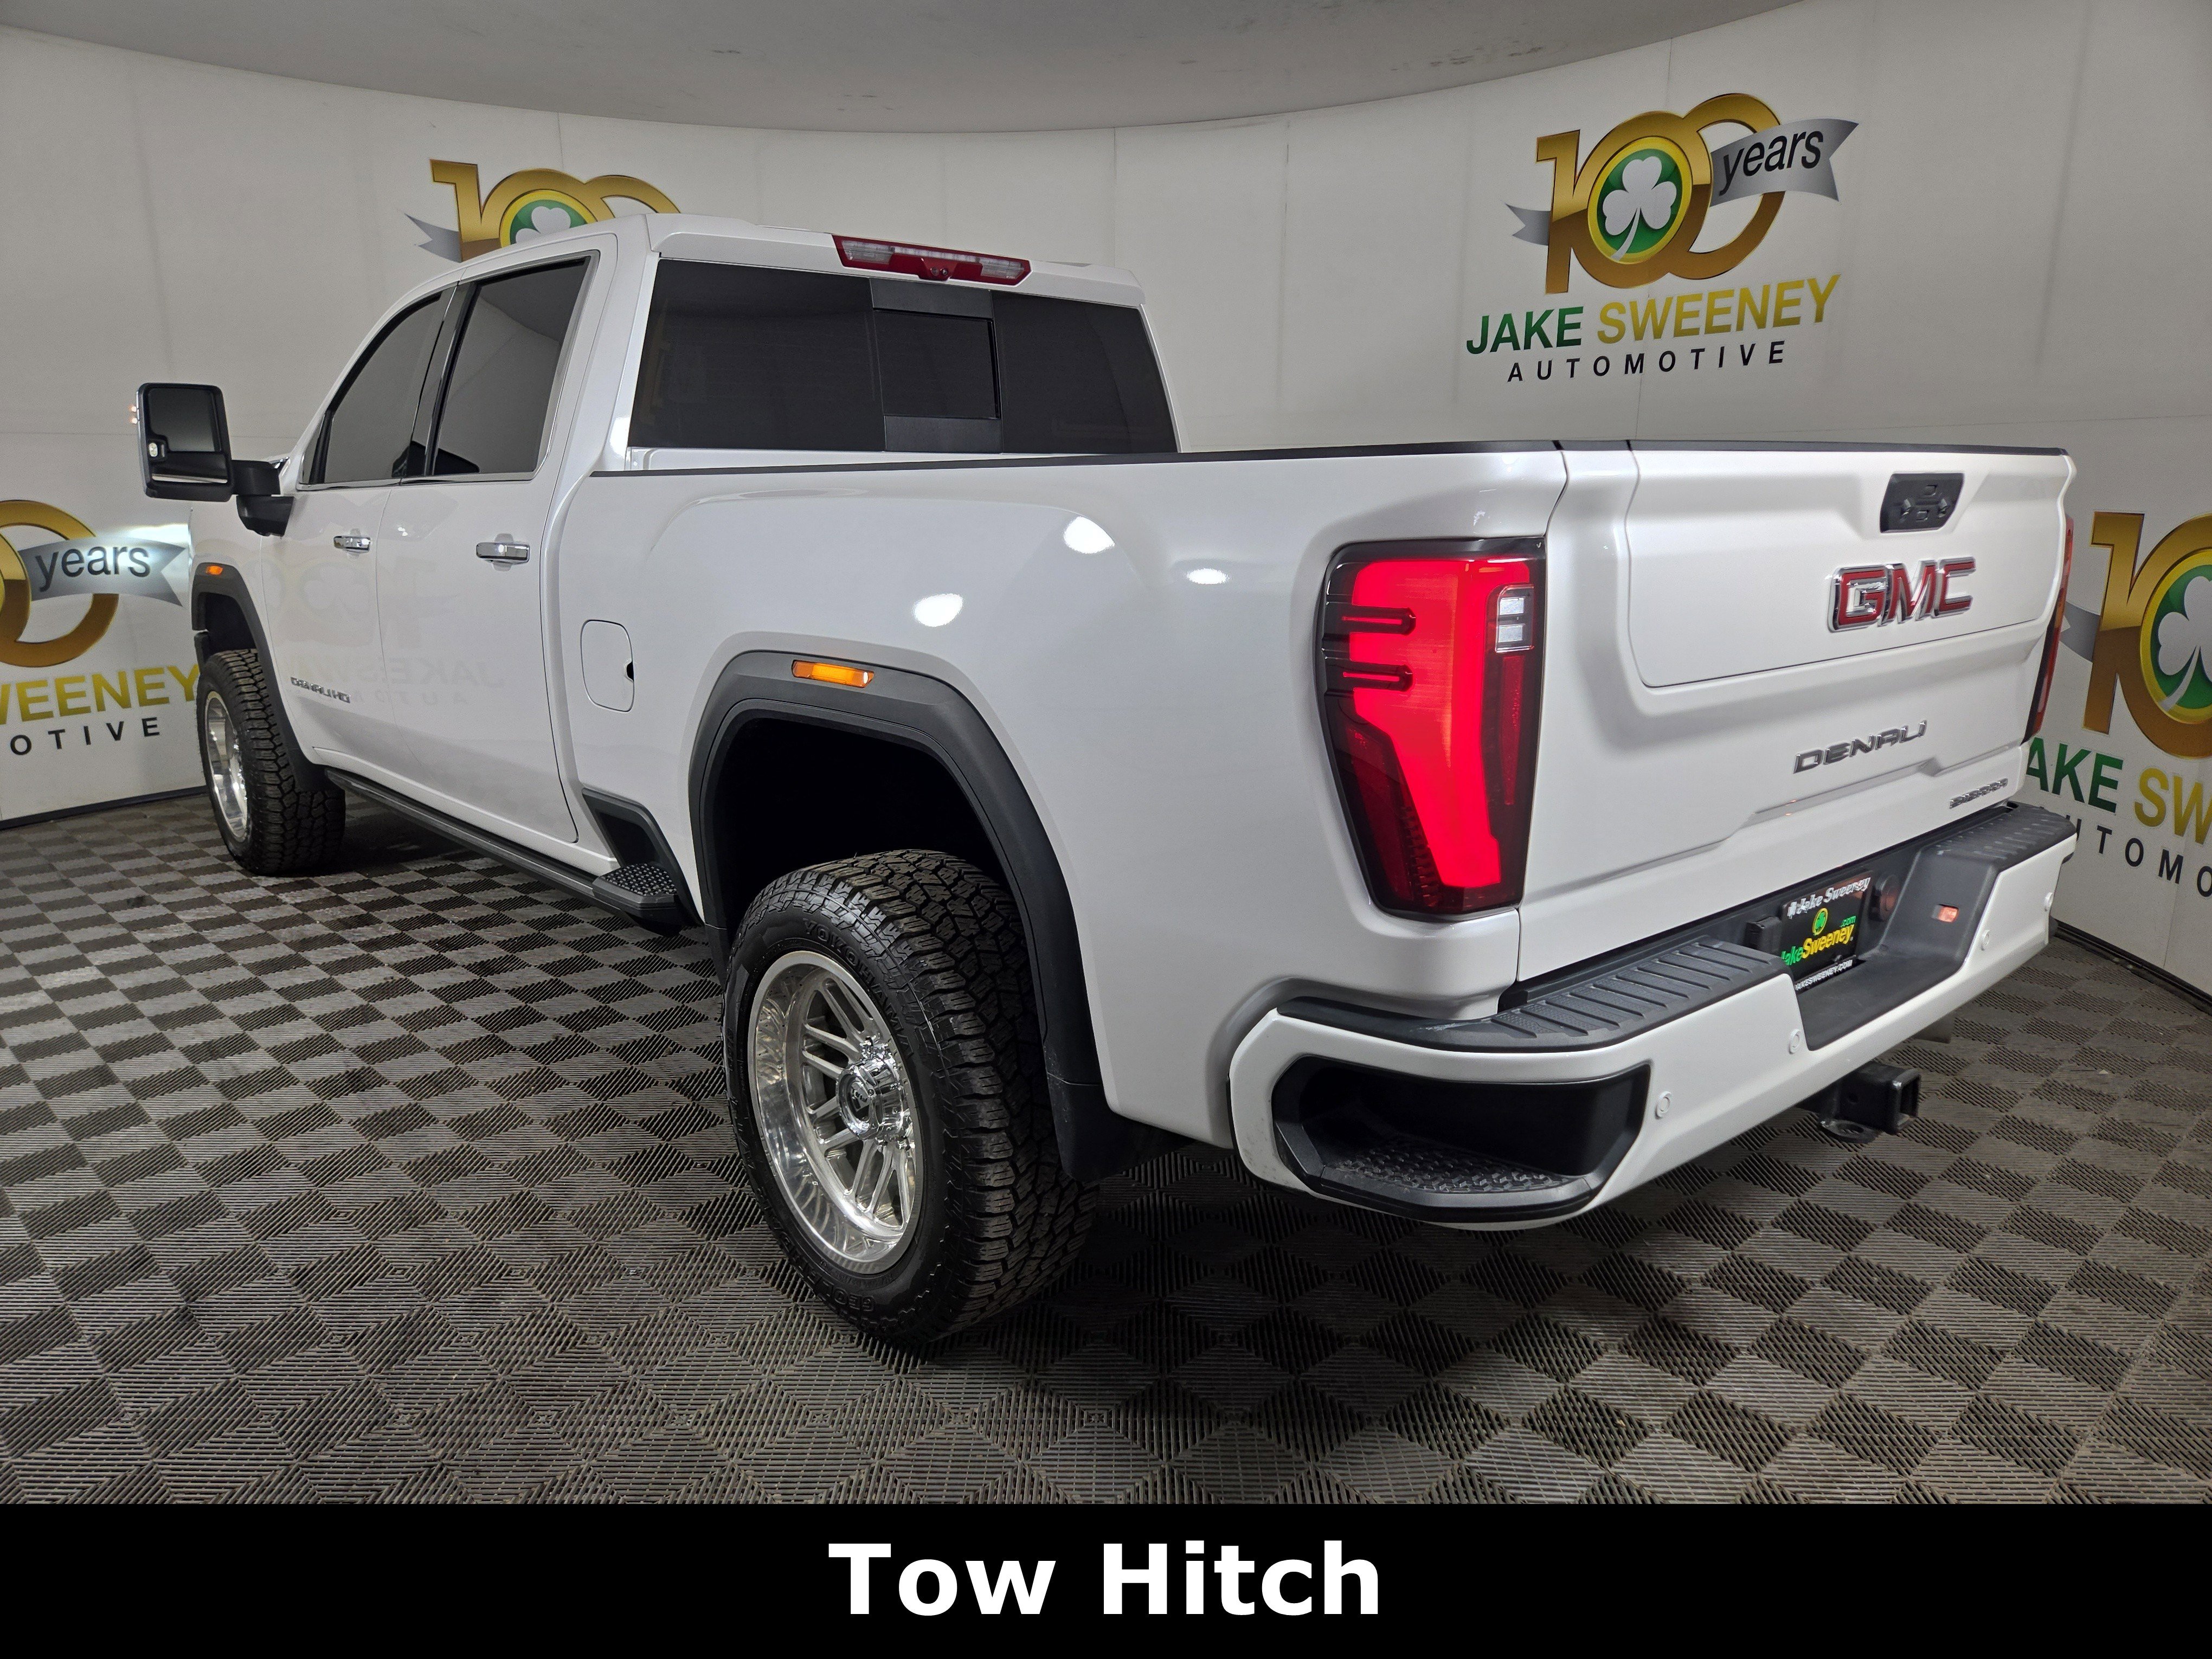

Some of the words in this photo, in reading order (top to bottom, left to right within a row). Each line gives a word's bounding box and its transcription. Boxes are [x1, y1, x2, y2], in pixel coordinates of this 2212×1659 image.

[1536, 93, 1785, 294] 100
[1719, 129, 1823, 196] years
[1467, 306, 1584, 355] JAKE
[1597, 274, 1841, 344] SWEENEY
[1508, 341, 1785, 382] AUTOMOTIVE
[35, 546, 151, 592] years
[1827, 556, 1976, 633] GMC
[0, 664, 199, 725] EENEY
[1793, 719, 1927, 774] DENALI
[2025, 737, 2124, 813] AKE
[2066, 814, 2212, 897] TOMO
[1823, 877, 1871, 903] Sweeney
[802, 917, 915, 1057] YOKOHAMA
[1795, 959, 1853, 991] AKESWEENEY.COM
